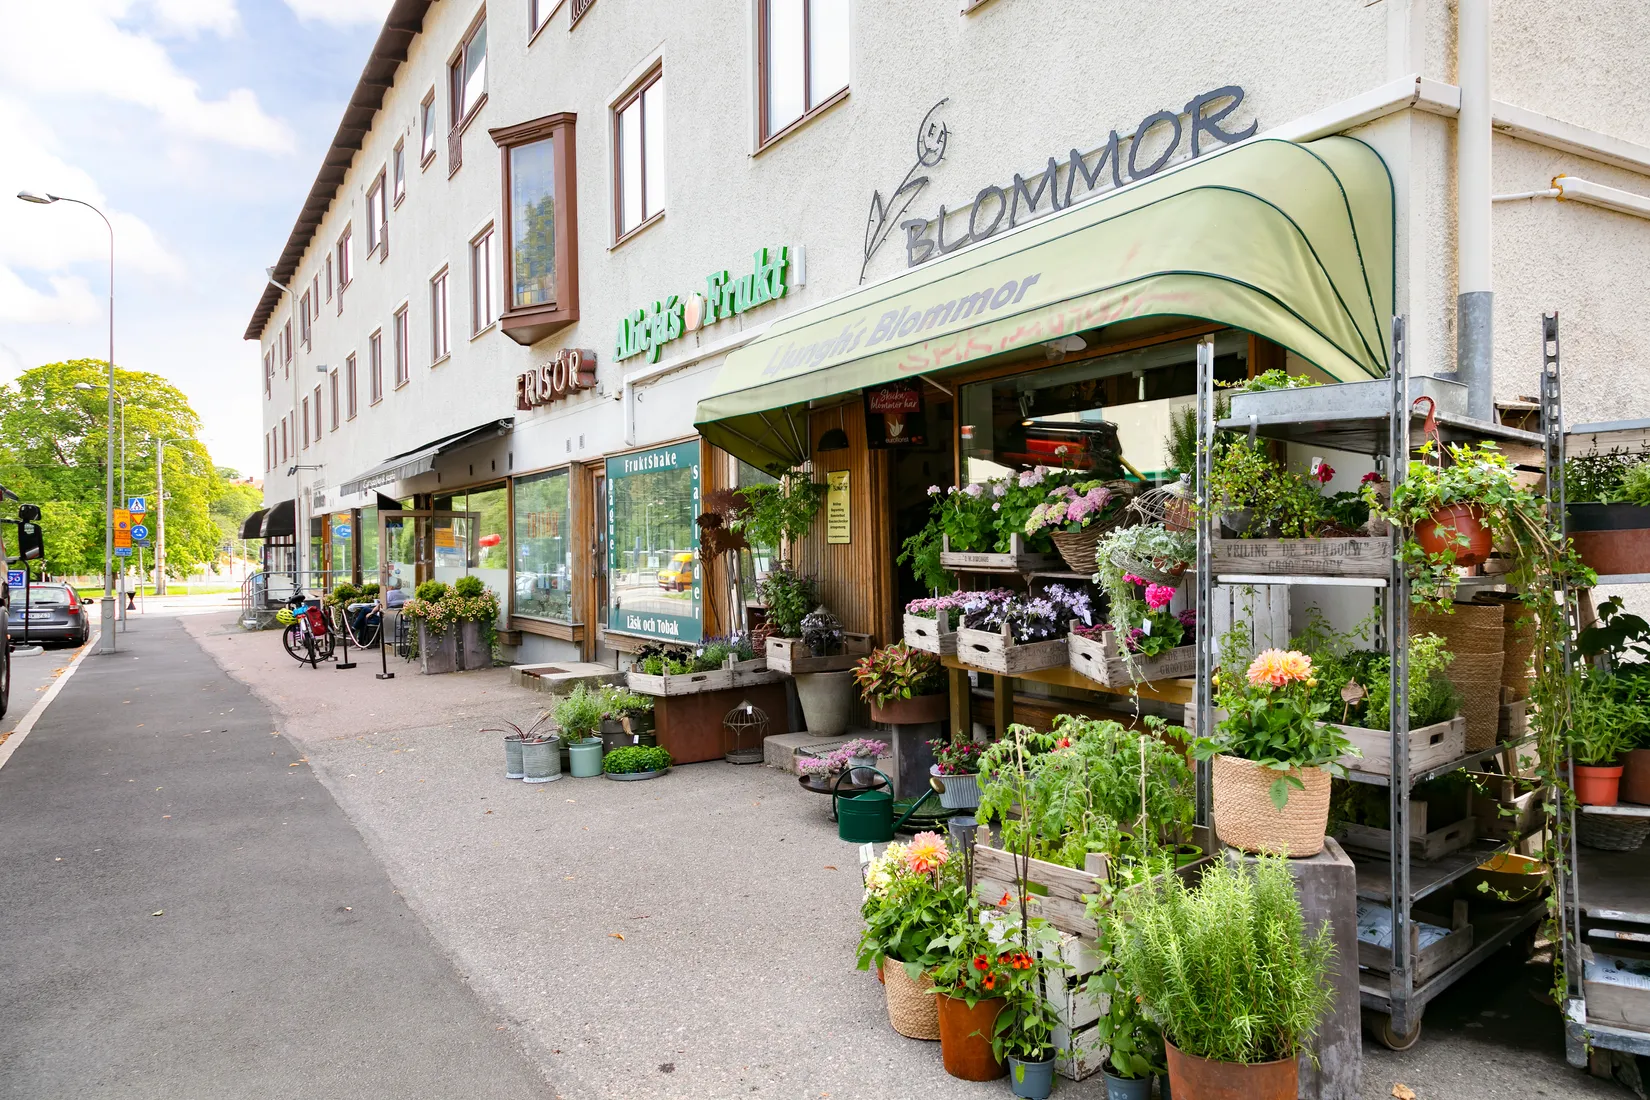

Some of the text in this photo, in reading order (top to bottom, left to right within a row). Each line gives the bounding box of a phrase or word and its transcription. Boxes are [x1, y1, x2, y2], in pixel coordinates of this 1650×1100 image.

[901, 85, 1258, 268] BLOMMOR
[703, 246, 789, 326] Frukt
[864, 273, 1041, 347] Blommor
[515, 349, 597, 411] FRISÖR
[870, 396, 918, 410] blommor här
[624, 451, 677, 473] FruktShake
[1227, 544, 1268, 557] VEILING
[1276, 544, 1296, 557] "DE
[626, 614, 679, 636] Läsk och Tobak
